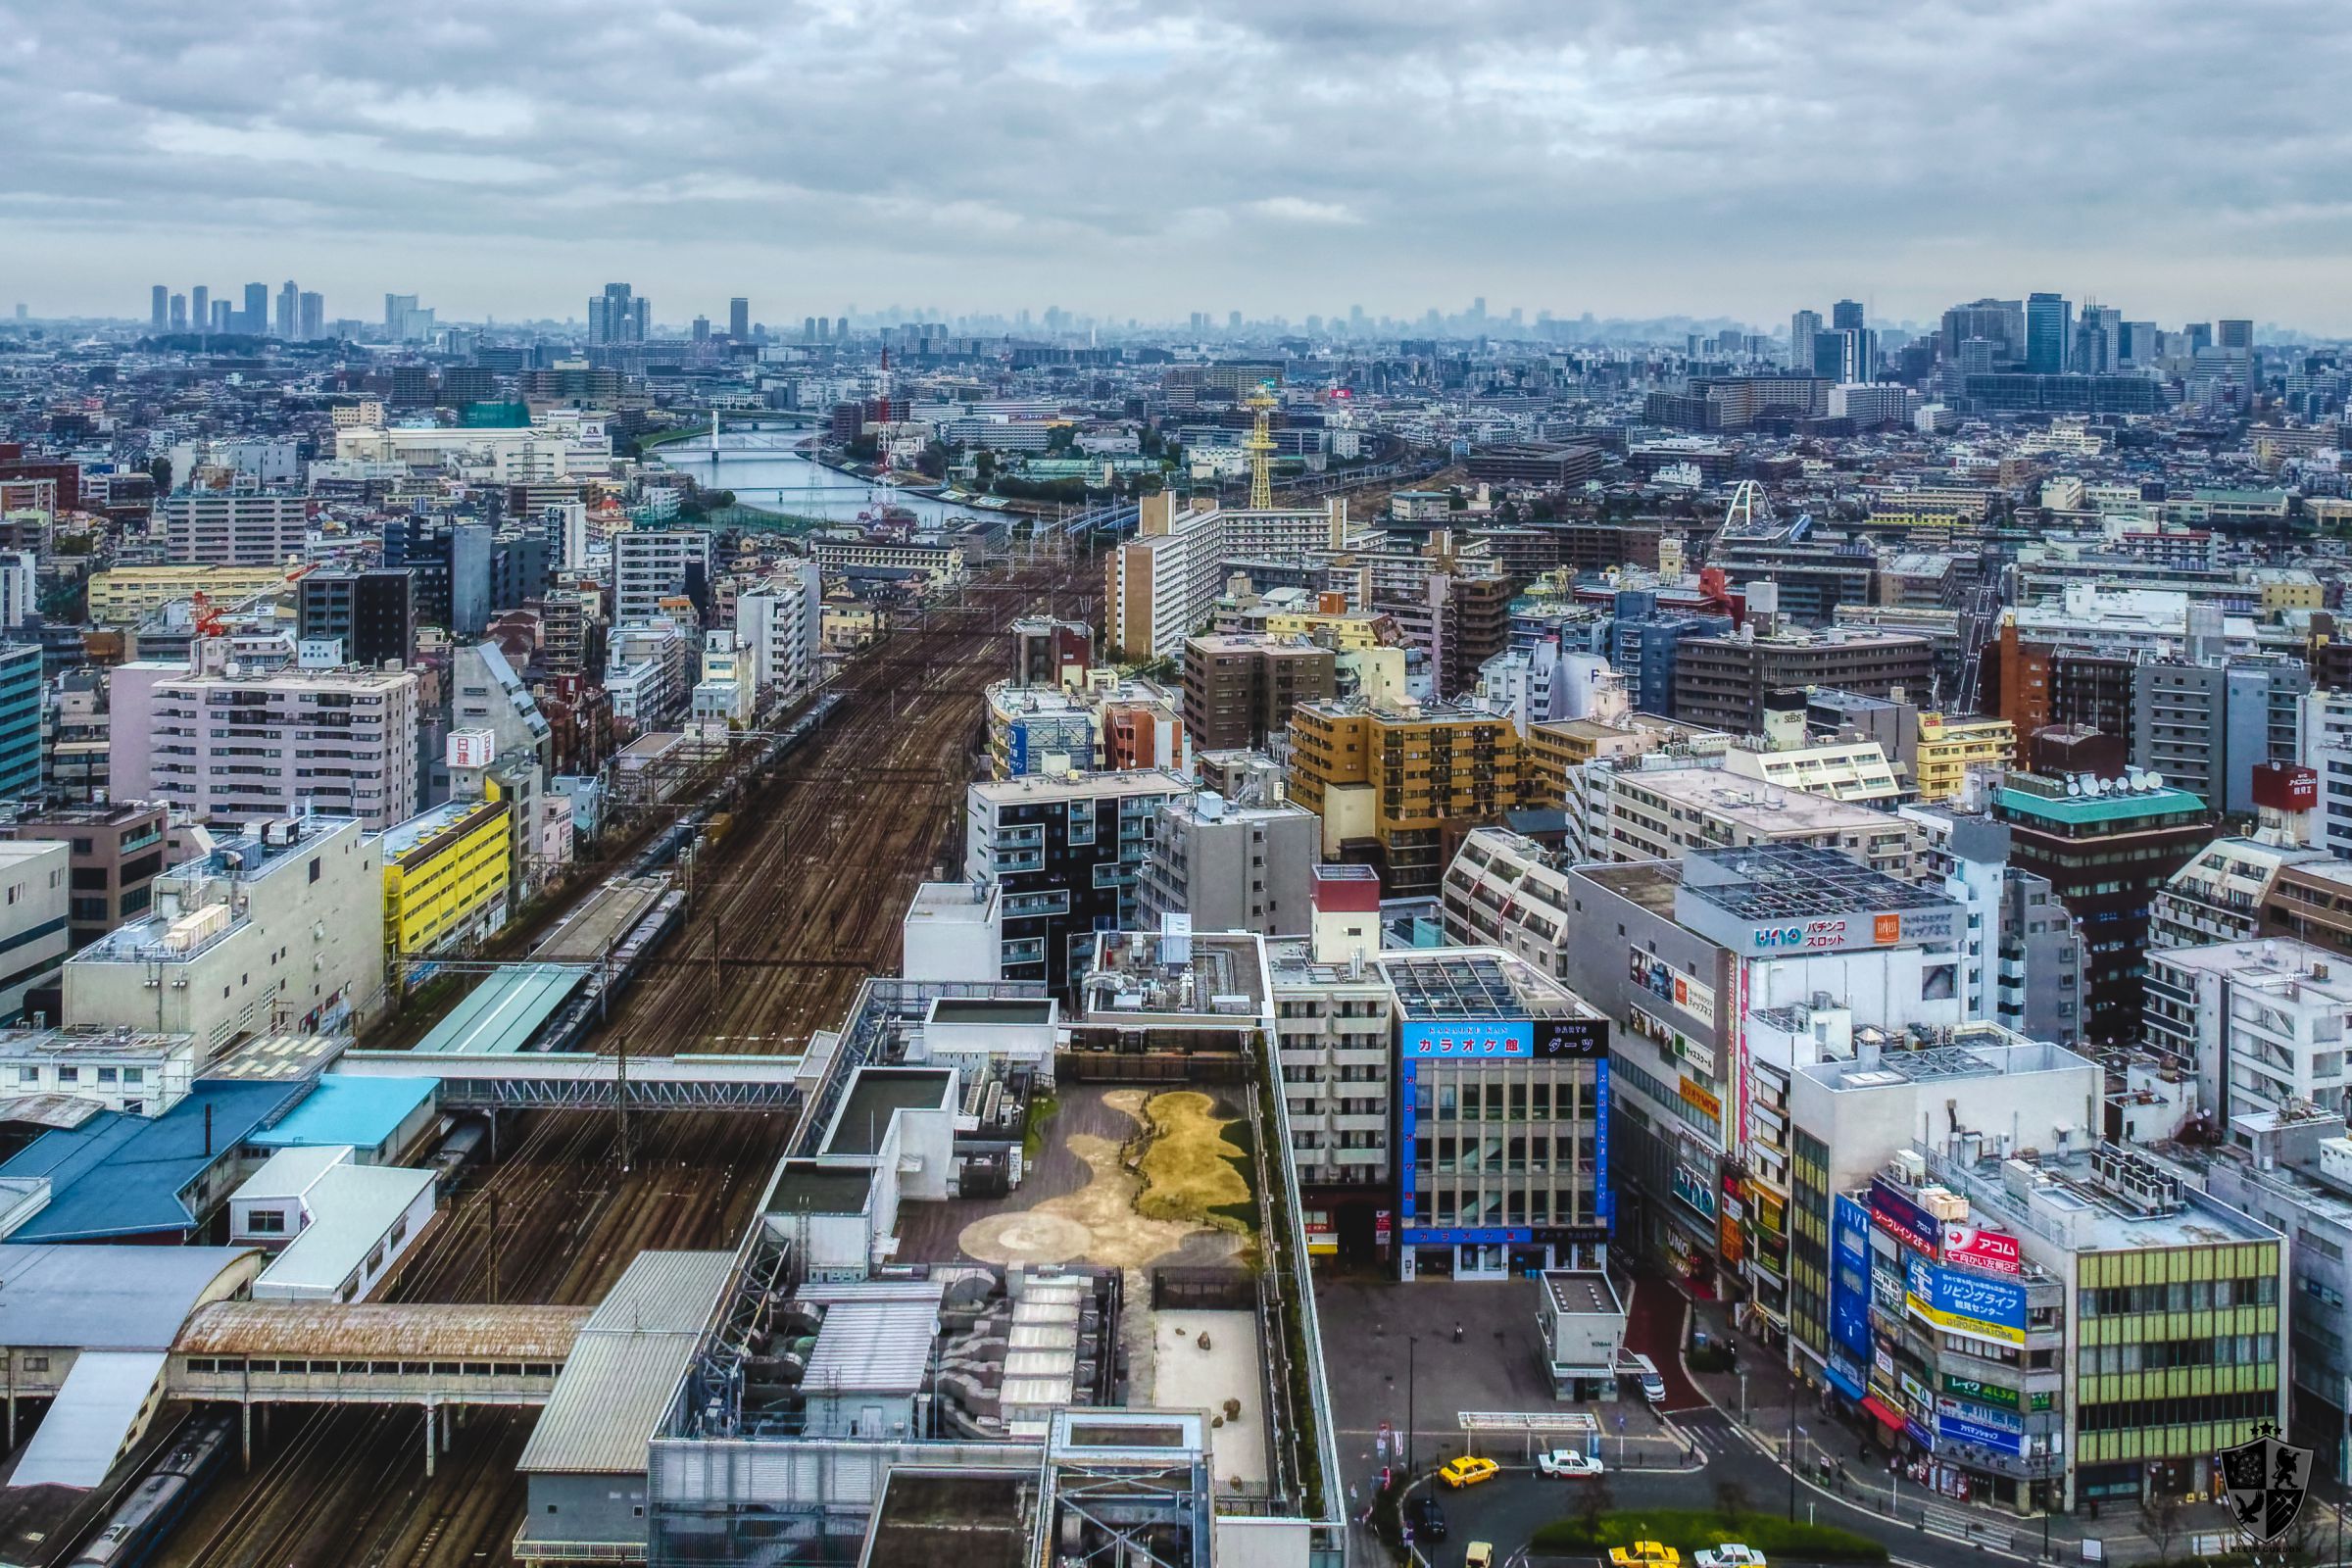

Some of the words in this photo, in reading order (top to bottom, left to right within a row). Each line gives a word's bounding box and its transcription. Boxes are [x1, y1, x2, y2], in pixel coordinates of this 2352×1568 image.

[457, 738, 469, 765] 日建
[1805, 919, 1846, 934] パチンコ
[1805, 934, 1845, 948] スロット
[1419, 1039, 1519, 1052] カラオケ館
[1548, 1038, 1593, 1053] ダーツ
[1913, 1234, 1924, 1249] 2F
[1979, 1238, 2016, 1256] アコム
[1959, 1254, 2017, 1273] 向かい左側2F
[1942, 1284, 2017, 1309] リビングライフ
[1951, 1377, 1981, 1392] レイク
[1982, 1385, 2017, 1401] ALSA
